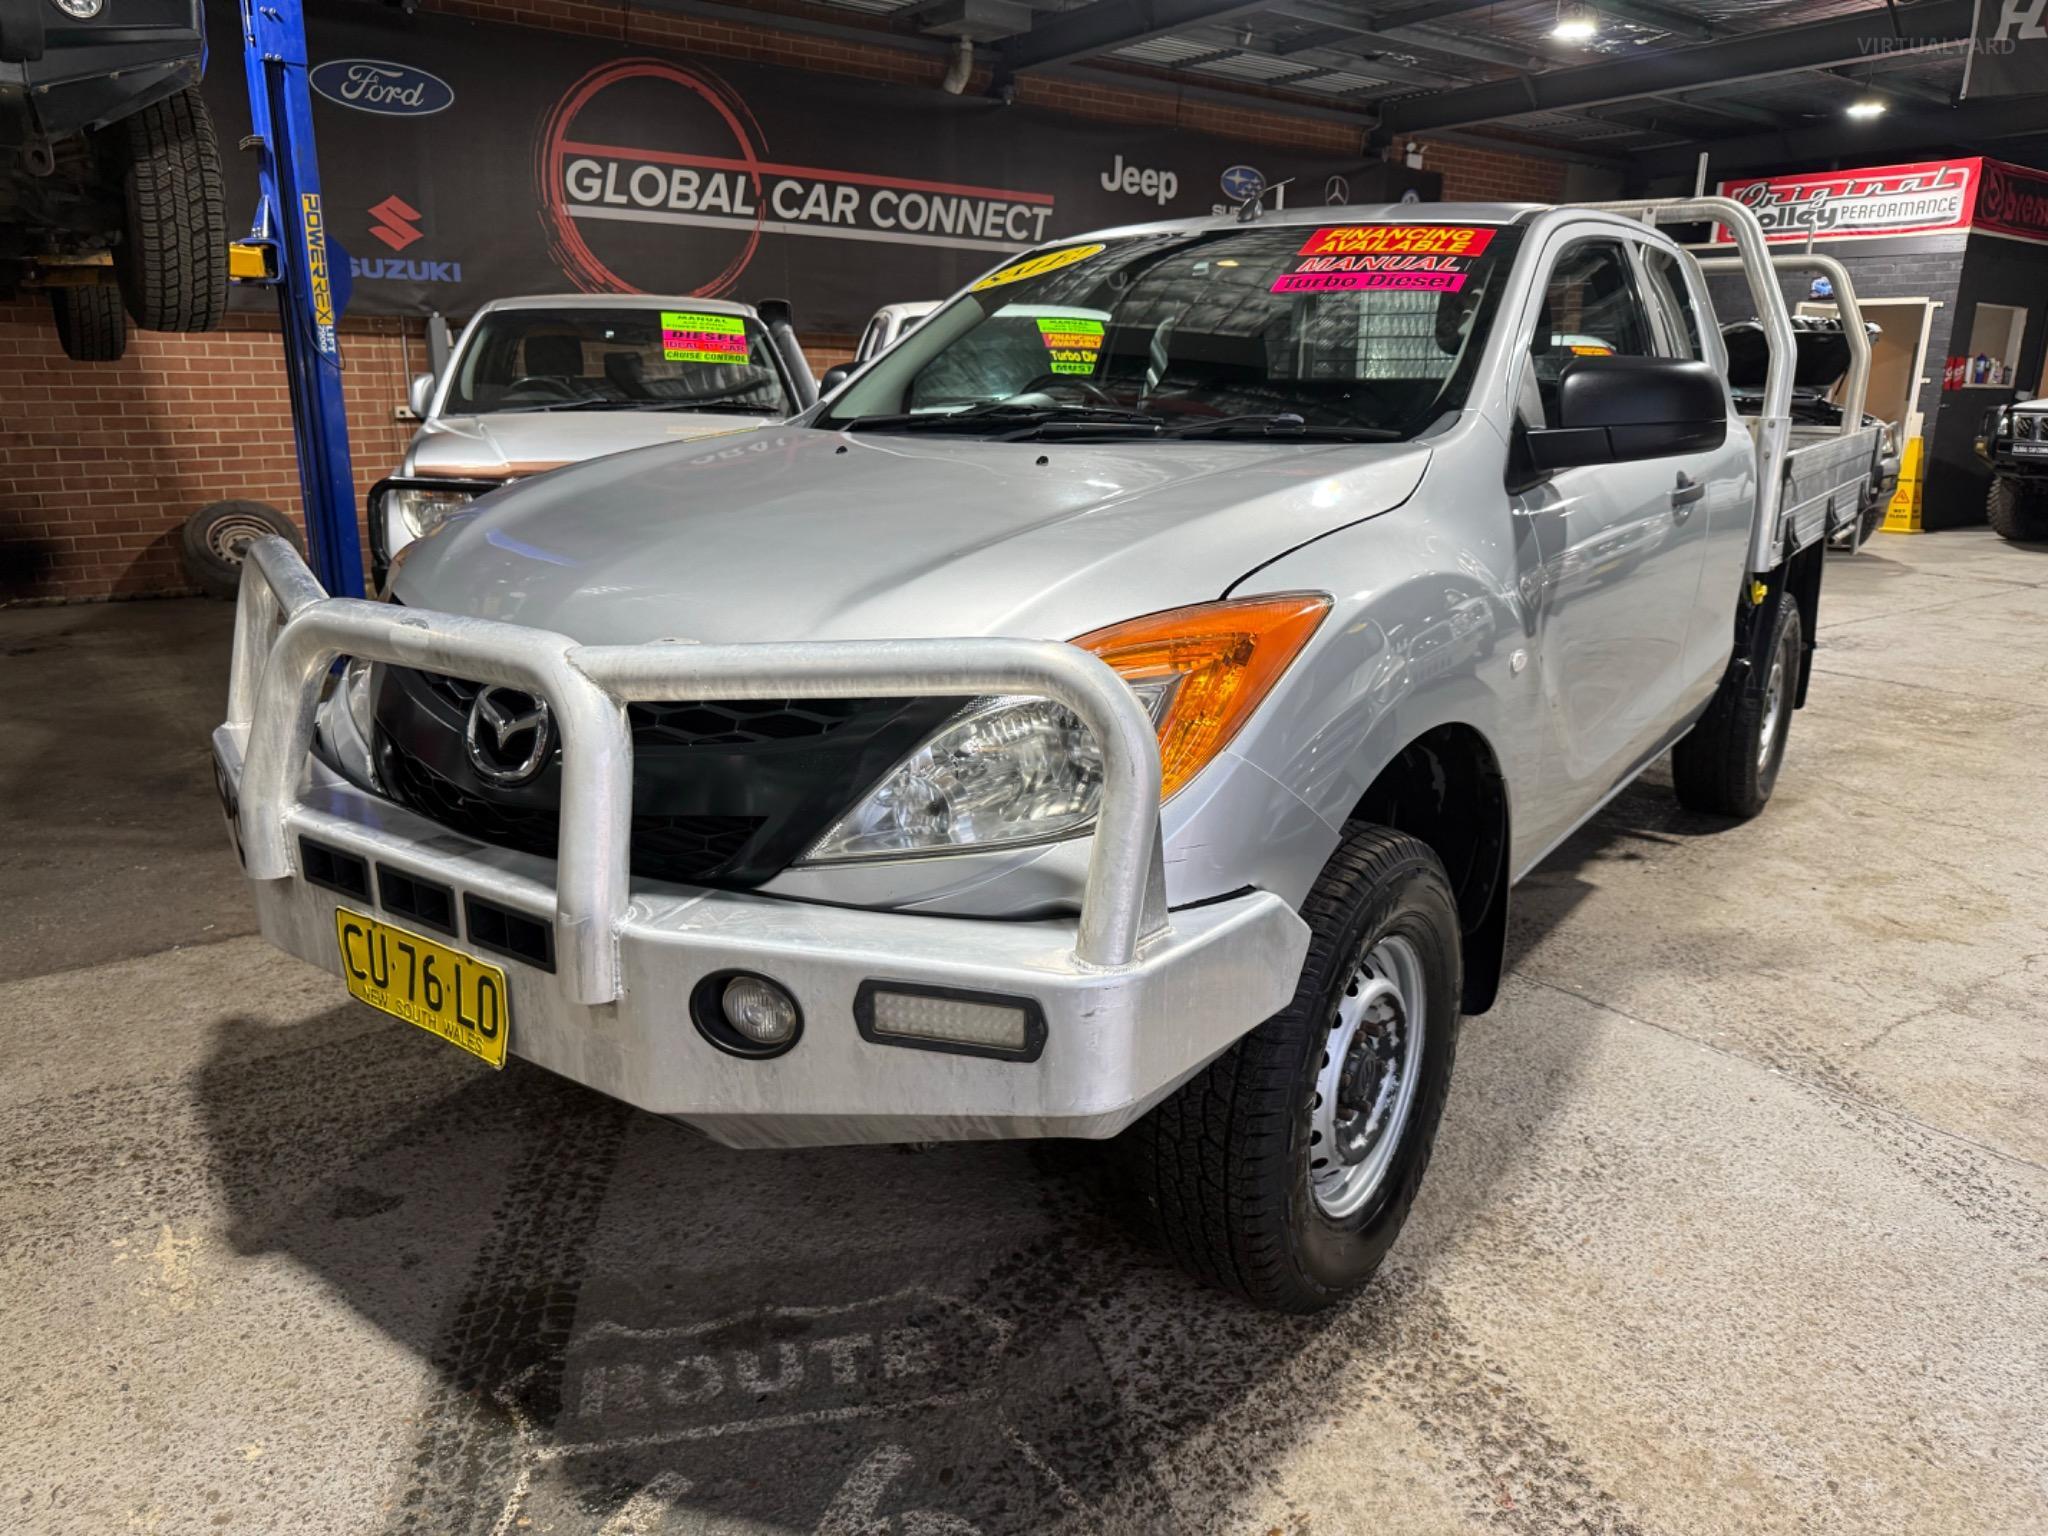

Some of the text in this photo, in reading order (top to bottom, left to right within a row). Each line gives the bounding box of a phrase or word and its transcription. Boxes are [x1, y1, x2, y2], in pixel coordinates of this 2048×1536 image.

[341, 64, 425, 109] Ford
[1101, 154, 1178, 206] Jeep
[1738, 167, 1957, 210] Original
[566, 159, 1053, 242] GLOBAL CAR CONNECT
[1840, 195, 1959, 221] PERFORMANCE
[1315, 239, 1471, 253] AVAILABLE
[1325, 228, 1476, 241] FINANCING
[304, 194, 332, 325] POWERREX
[350, 256, 462, 283] SUZUKI
[1295, 255, 1462, 273] MANUAL
[1284, 274, 1457, 289] Turbo Diesel
[673, 331, 742, 343] DIESEL
[666, 350, 747, 363] CRUISE CONTROL
[1049, 350, 1081, 361] Turbo
[364, 983, 484, 1054] NEW SOUTH WALES
